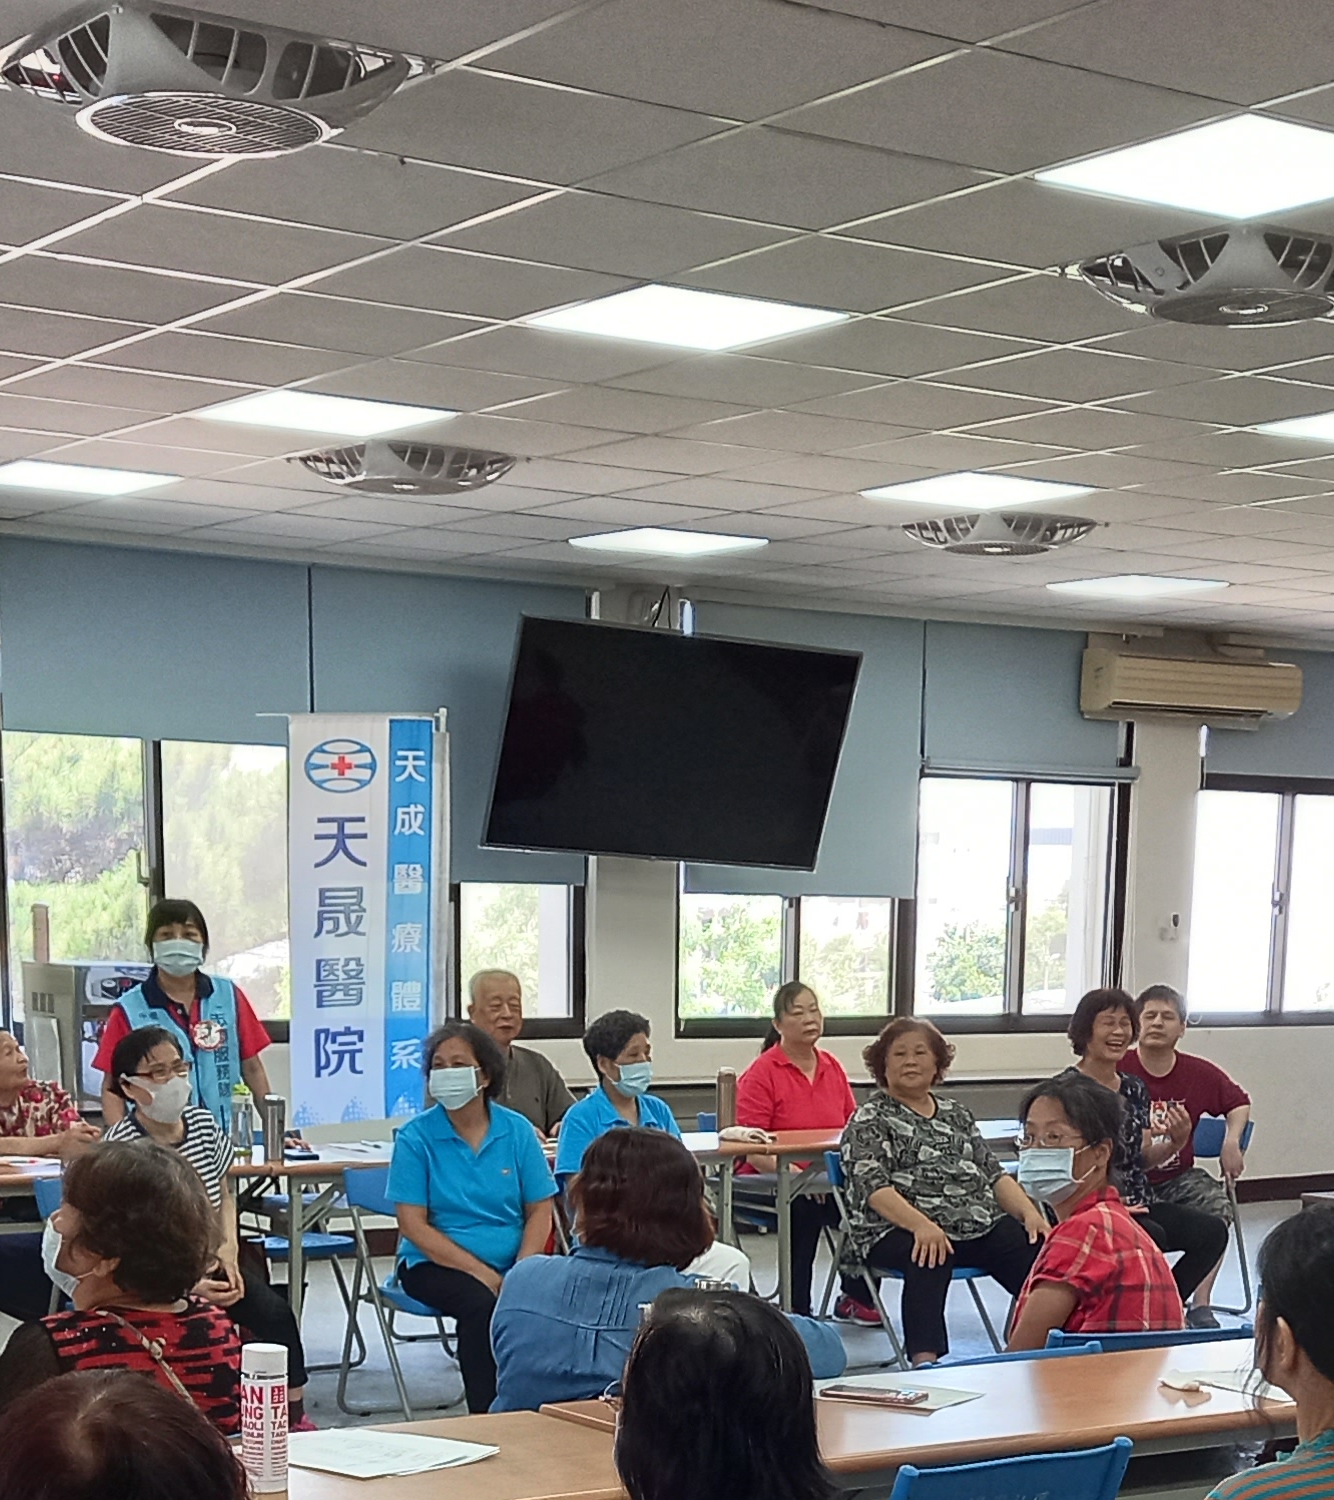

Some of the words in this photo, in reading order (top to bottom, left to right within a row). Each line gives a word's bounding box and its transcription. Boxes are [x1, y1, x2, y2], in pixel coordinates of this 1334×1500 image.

[312, 815, 369, 1079] 天晟醫院
[390, 749, 427, 1070] 天成醫療體系
